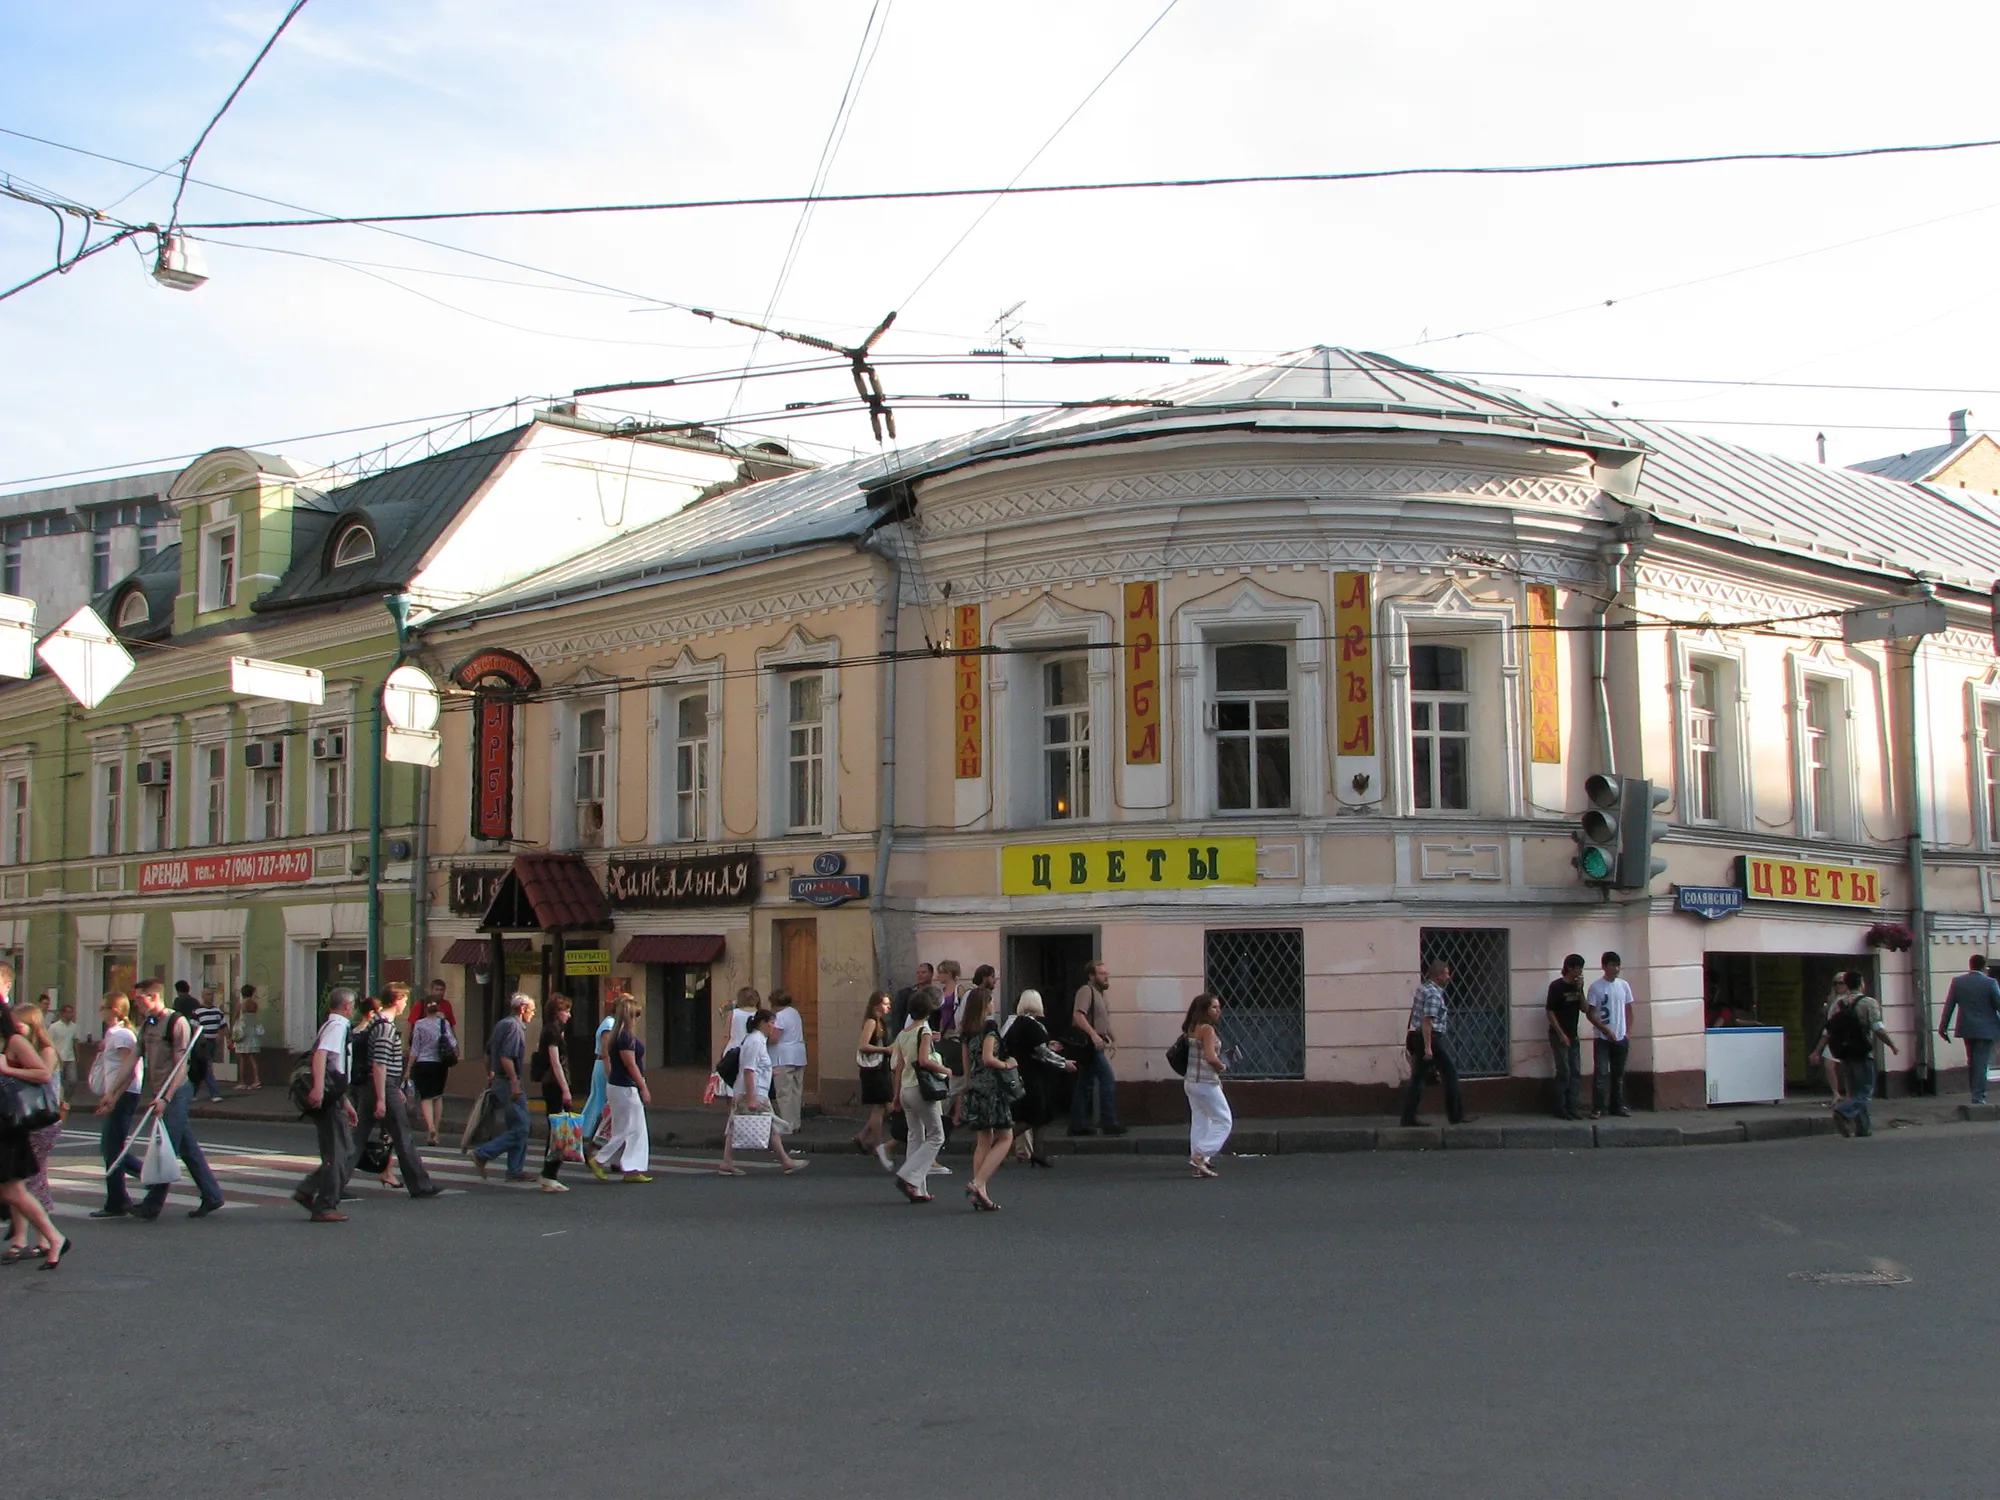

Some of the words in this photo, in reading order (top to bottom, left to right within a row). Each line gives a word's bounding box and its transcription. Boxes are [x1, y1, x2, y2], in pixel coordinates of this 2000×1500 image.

[1130, 583, 1156, 760] АРБА
[1340, 574, 1369, 752] ARBA
[960, 607, 978, 776] РЕСТОРАН
[486, 702, 503, 821] АРБА
[143, 861, 189, 887] АРЕНДА
[219, 858, 231, 878] +7
[231, 856, 256, 882] (906)
[257, 851, 308, 876] 787-99-70
[820, 857, 835, 872] 2/6
[1032, 847, 1219, 890] ЦВЕТЫ
[1752, 862, 1876, 903] ЦВЕТЫ
[1684, 891, 1738, 905] СОЛЯНСКИЙ
[567, 951, 607, 960] ОТКРЫТО
[586, 964, 608, 973] ХАШ
